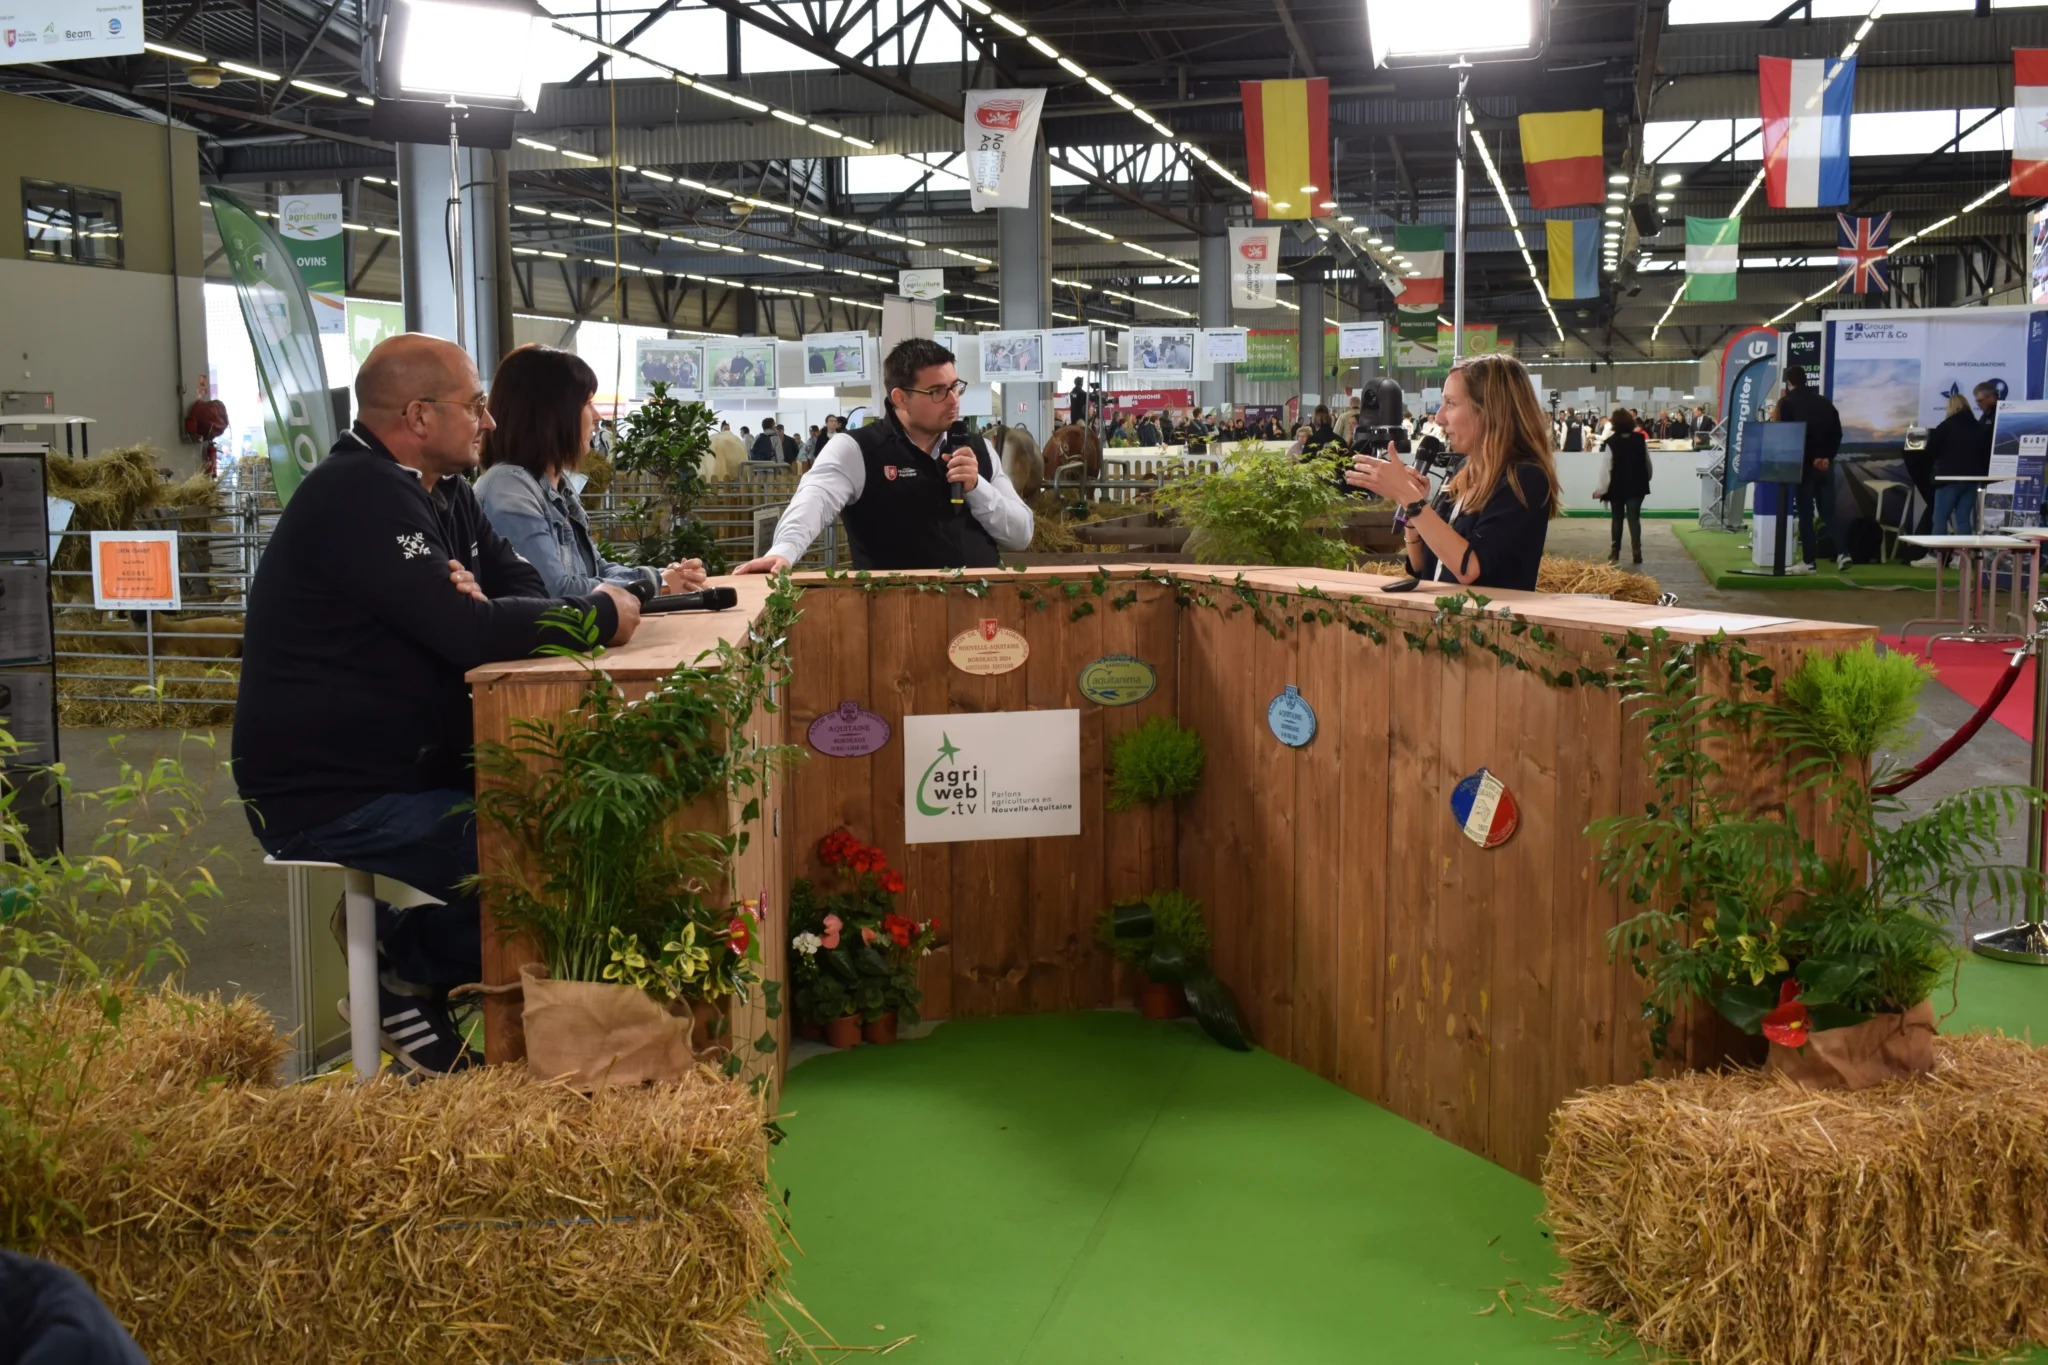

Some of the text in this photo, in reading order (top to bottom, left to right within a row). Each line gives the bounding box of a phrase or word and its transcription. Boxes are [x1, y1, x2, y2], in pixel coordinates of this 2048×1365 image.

[65, 30, 92, 39] Beam
[977, 134, 991, 193] Aquitaine
[288, 212, 337, 222] agriculture
[296, 256, 327, 267] OVINS
[1863, 323, 1894, 331] Groupe
[1863, 331, 1908, 339] WATT & Co
[1791, 341, 1815, 349] NOTUS
[950, 635, 966, 654] SALON
[958, 643, 1020, 651] NOUVELLE-AQUITAINE
[1092, 675, 1141, 686] aquitanima
[809, 717, 826, 736] SALON
[827, 712, 837, 720] DE
[828, 724, 871, 733] AQUITAINE
[934, 765, 978, 787] agri
[934, 783, 978, 800] web
[991, 797, 1040, 806] agricultures
[951, 801, 977, 815] .tv
[991, 803, 1073, 814] Nouvelle-Aquitaine
